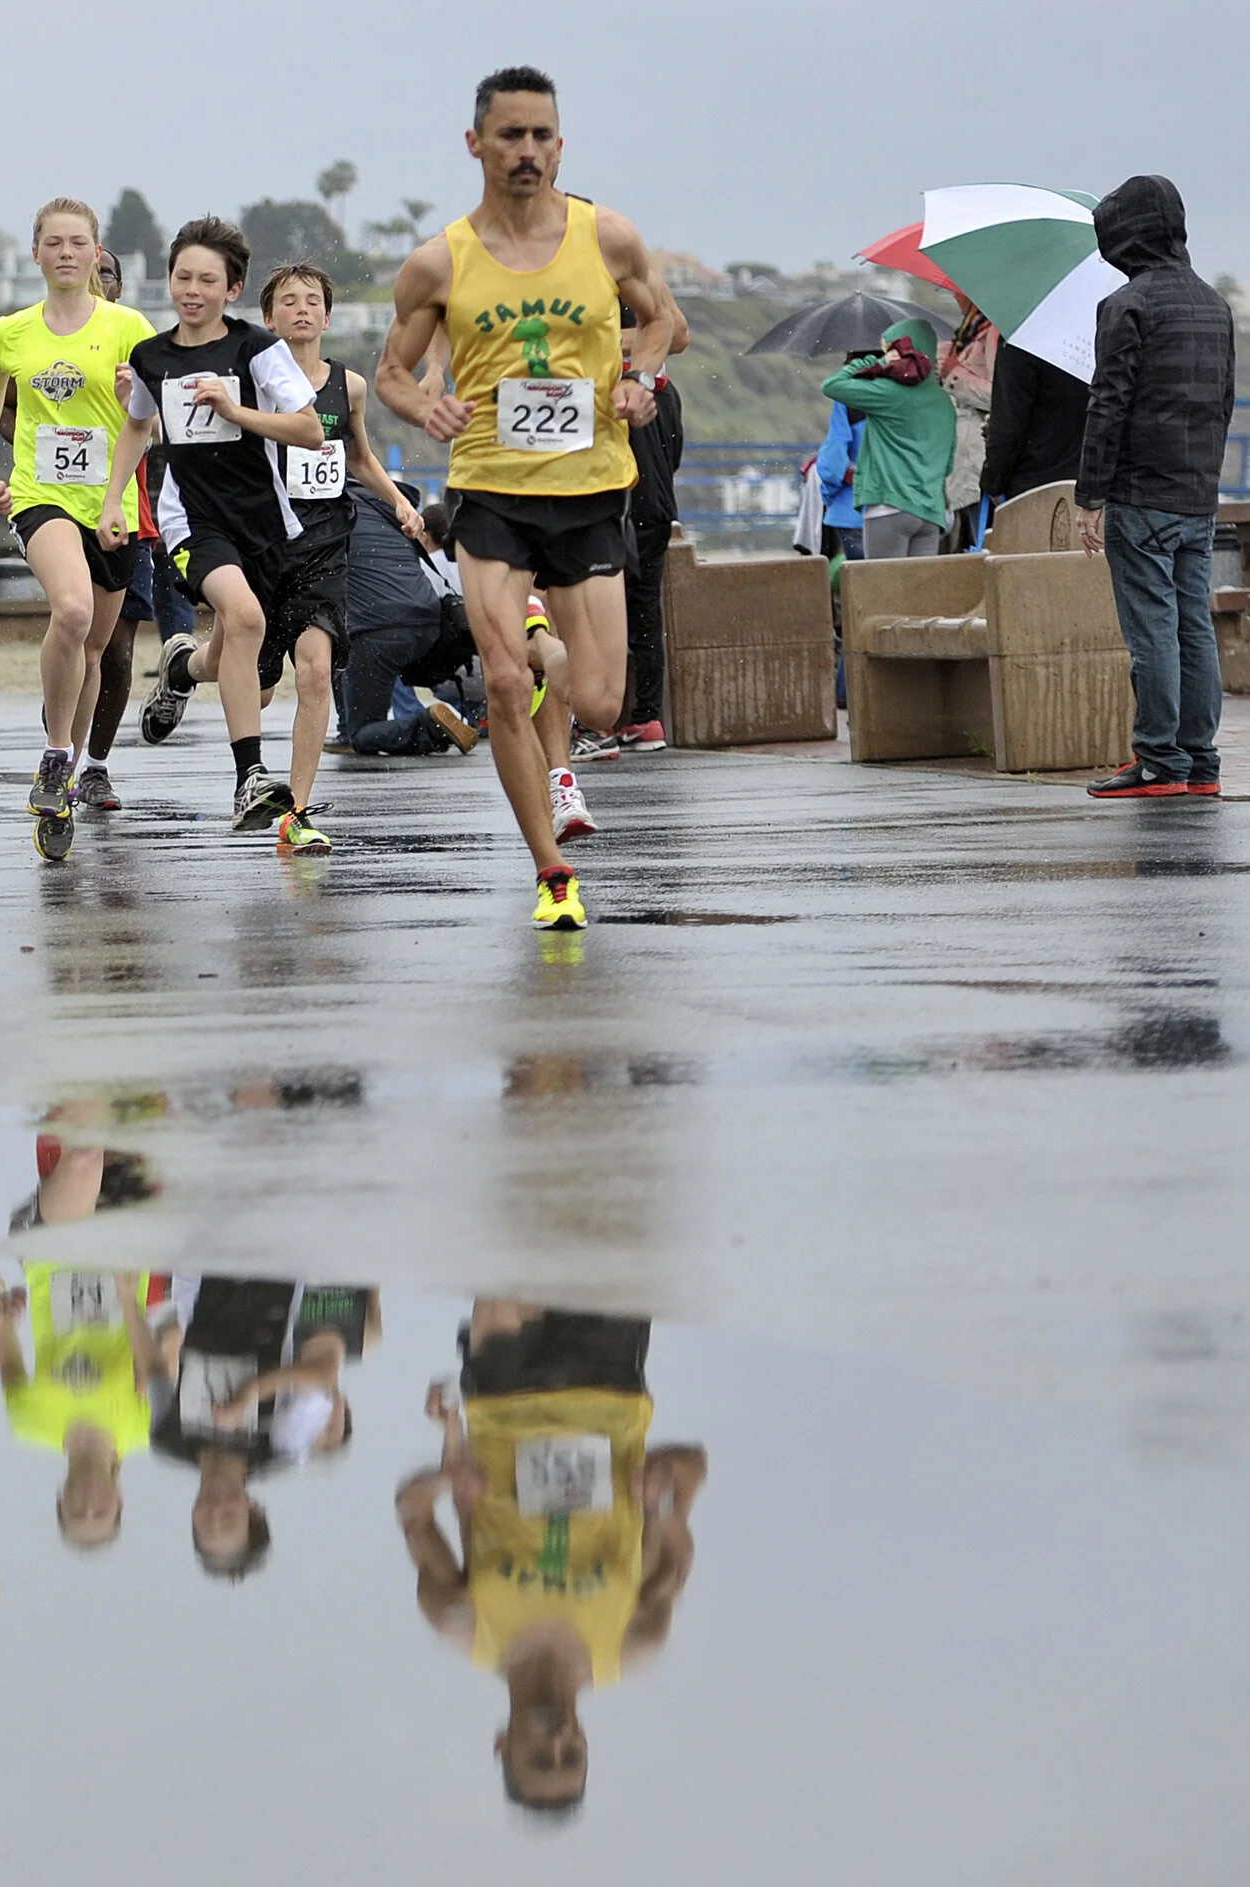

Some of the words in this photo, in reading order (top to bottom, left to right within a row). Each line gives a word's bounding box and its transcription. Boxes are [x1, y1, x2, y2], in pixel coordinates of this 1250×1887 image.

[475, 299, 586, 333] JAMUL
[31, 376, 85, 389] STORM
[183, 402, 216, 427] 77
[511, 405, 580, 433] 222
[54, 447, 90, 471] 54
[301, 461, 340, 484] 165
